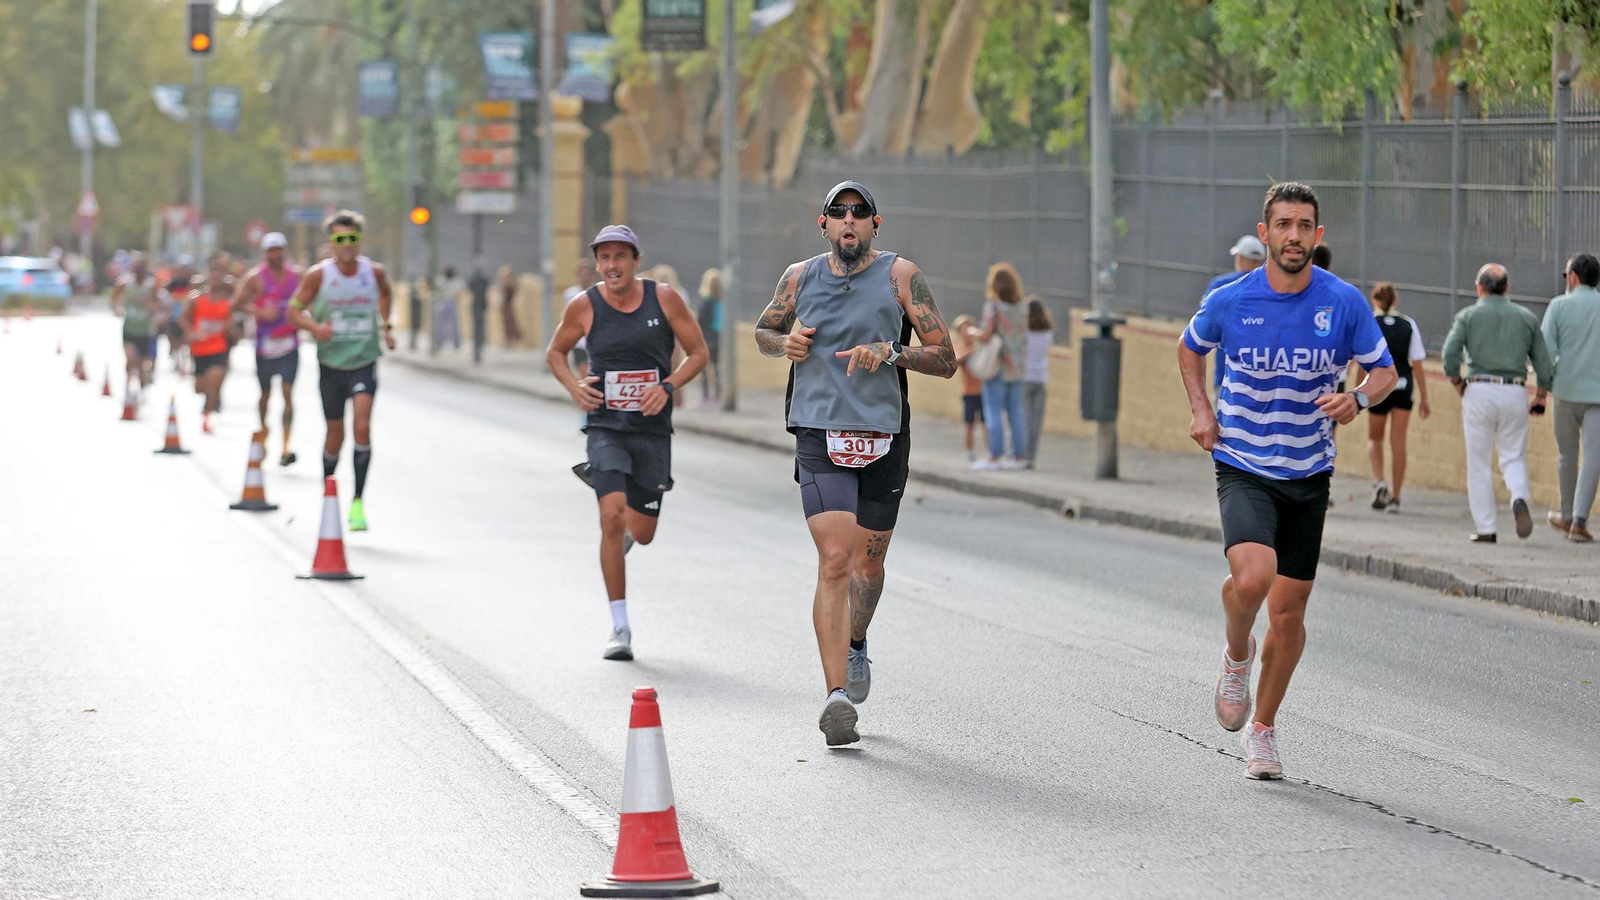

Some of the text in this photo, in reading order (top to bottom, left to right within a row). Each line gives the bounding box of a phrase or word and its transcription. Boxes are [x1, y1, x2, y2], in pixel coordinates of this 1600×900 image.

[1241, 316, 1265, 325] vive
[1238, 347, 1336, 372] CHAPIN
[843, 438, 875, 454] 301
